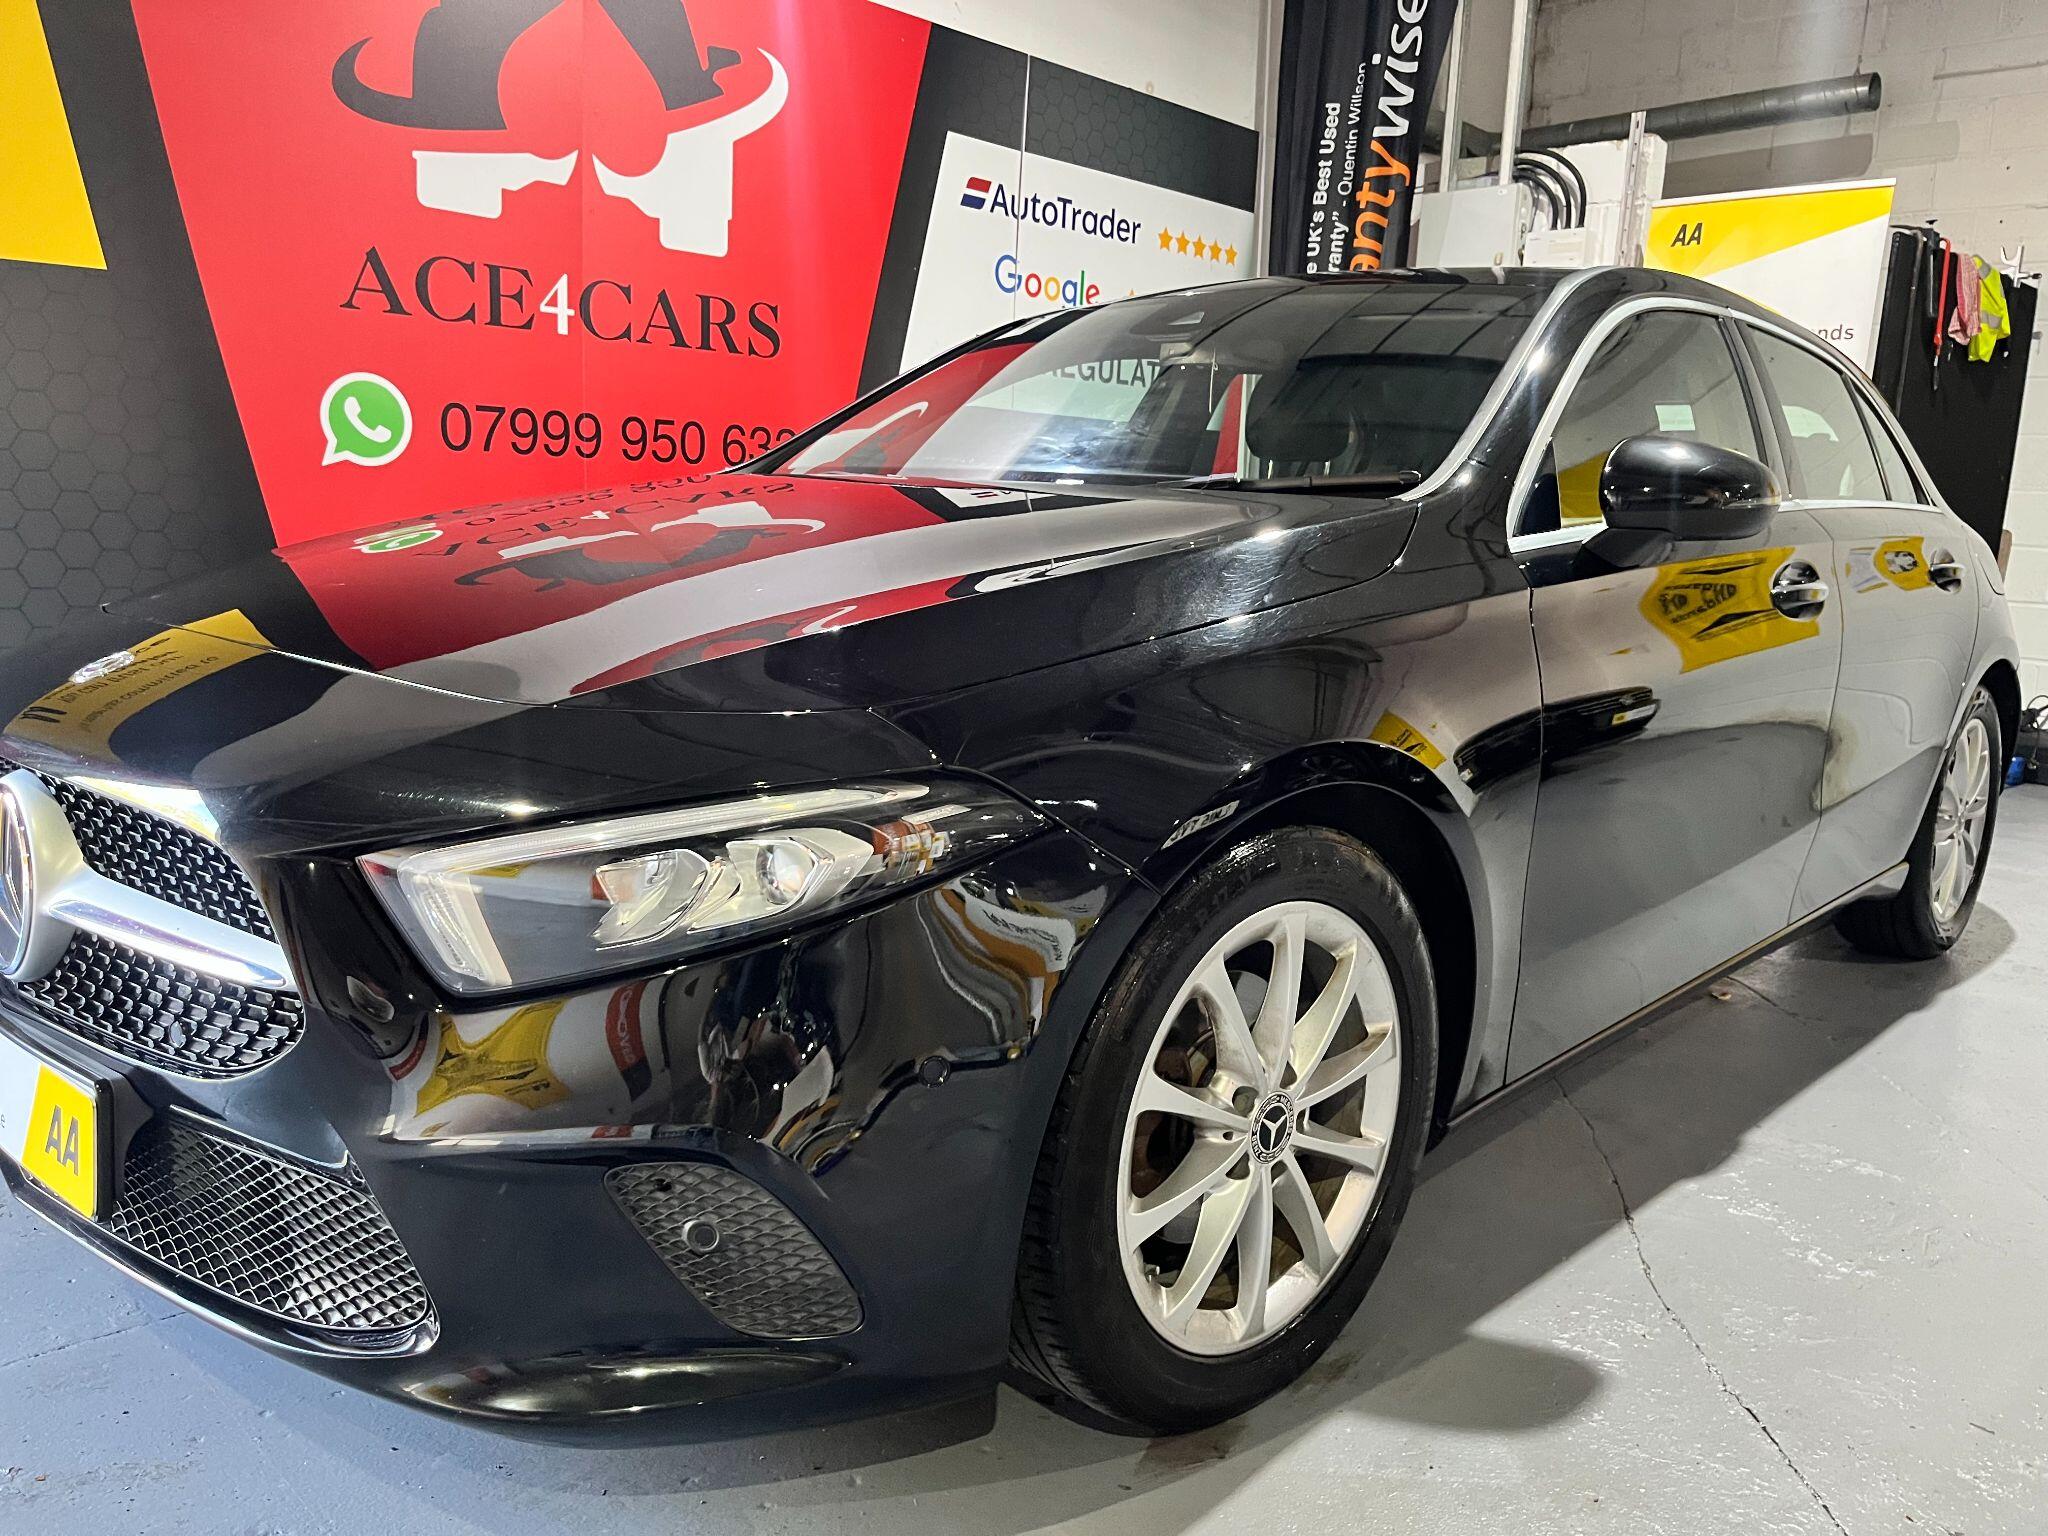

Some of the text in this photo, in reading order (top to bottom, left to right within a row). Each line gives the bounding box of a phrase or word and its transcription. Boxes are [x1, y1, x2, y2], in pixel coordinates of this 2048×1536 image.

[1348, 62, 1367, 125] Willson
[1318, 102, 1341, 154] Used
[1312, 159, 1333, 205] Best
[1338, 129, 1359, 195] Quentin
[989, 183, 1142, 244] AutoTrader
[1306, 210, 1325, 257] UK's
[1670, 222, 1704, 247] AA
[339, 245, 782, 359] ACE4CARS
[994, 254, 1100, 306] Google
[1812, 324, 1855, 341] nds
[1050, 358, 1161, 388] GULAT
[440, 402, 602, 458] 07999
[620, 417, 707, 465] 950
[44, 1104, 79, 1177] AA
